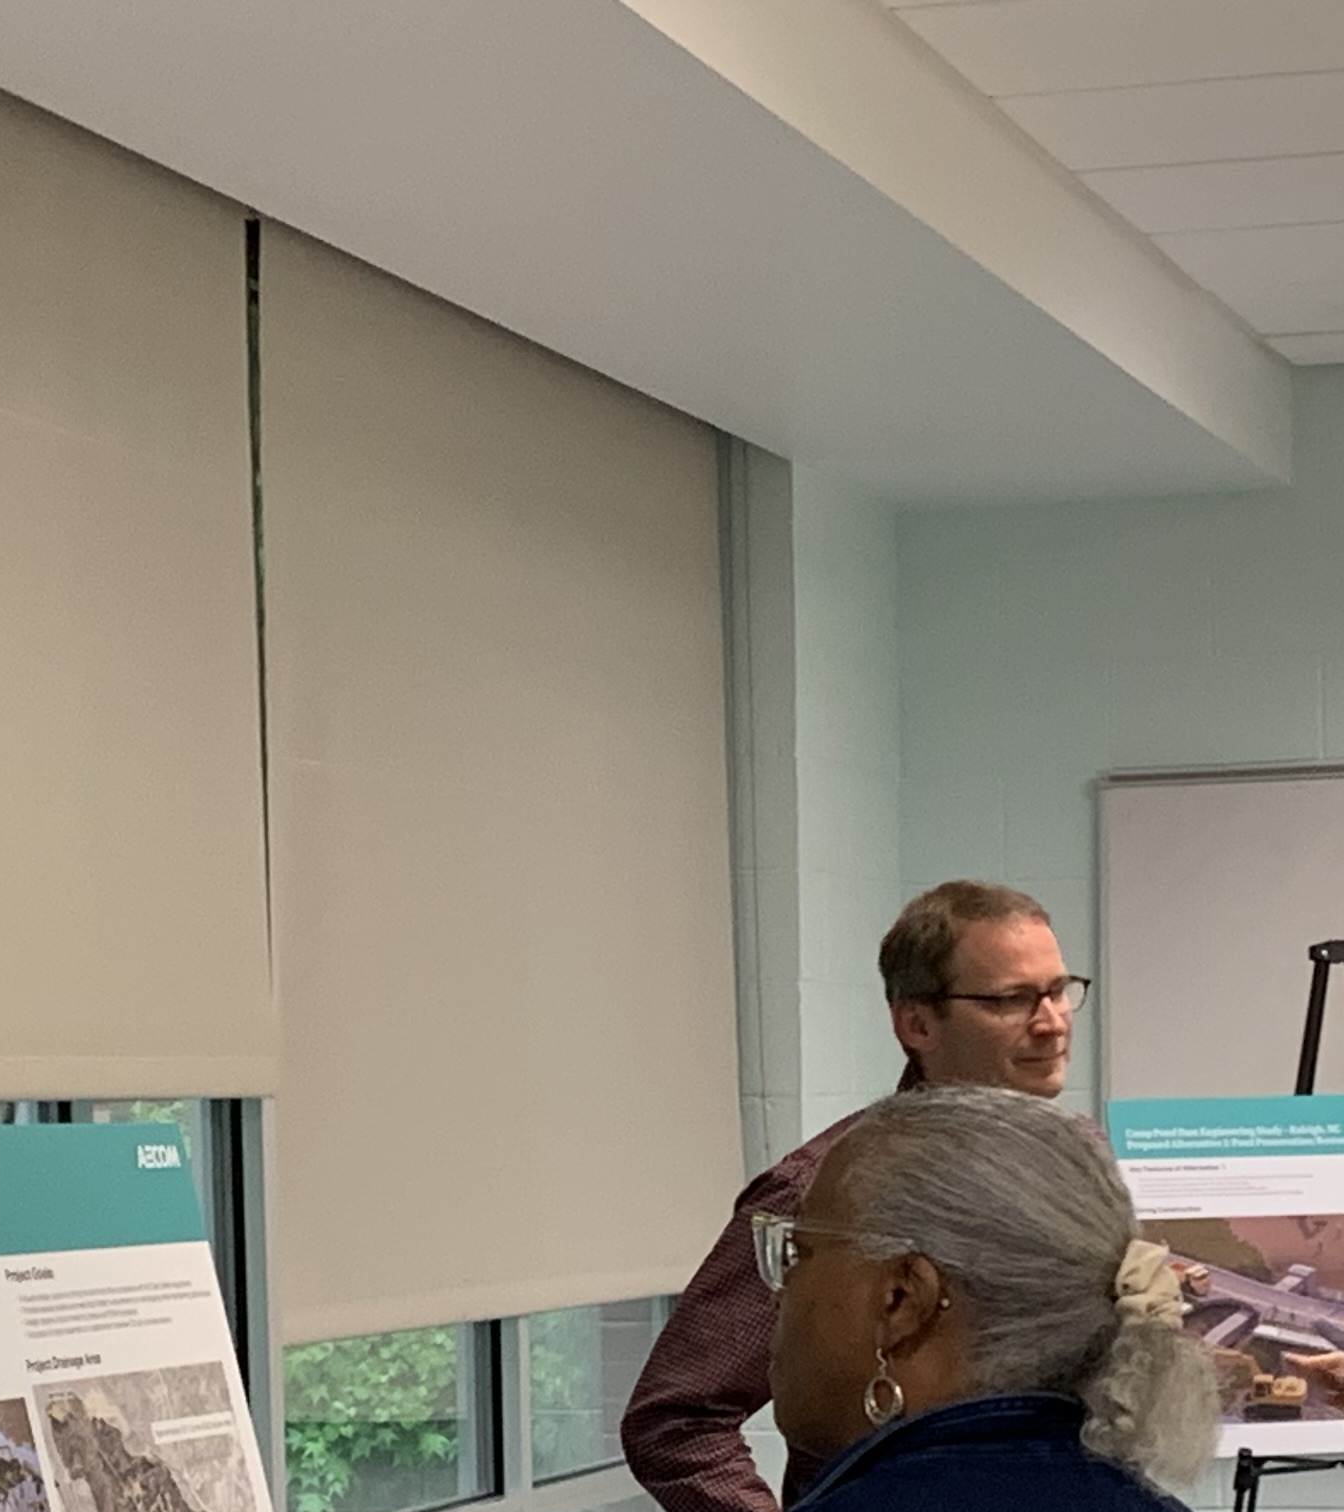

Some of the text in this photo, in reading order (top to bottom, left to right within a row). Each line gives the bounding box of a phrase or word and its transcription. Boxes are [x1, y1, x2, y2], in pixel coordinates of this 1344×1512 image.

[1256, 1125, 1282, 1137] Study
[137, 1144, 181, 1168] AECOM
[4, 1268, 31, 1283] Project
[25, 1359, 52, 1373] Project
[84, 1353, 101, 1365] Area
